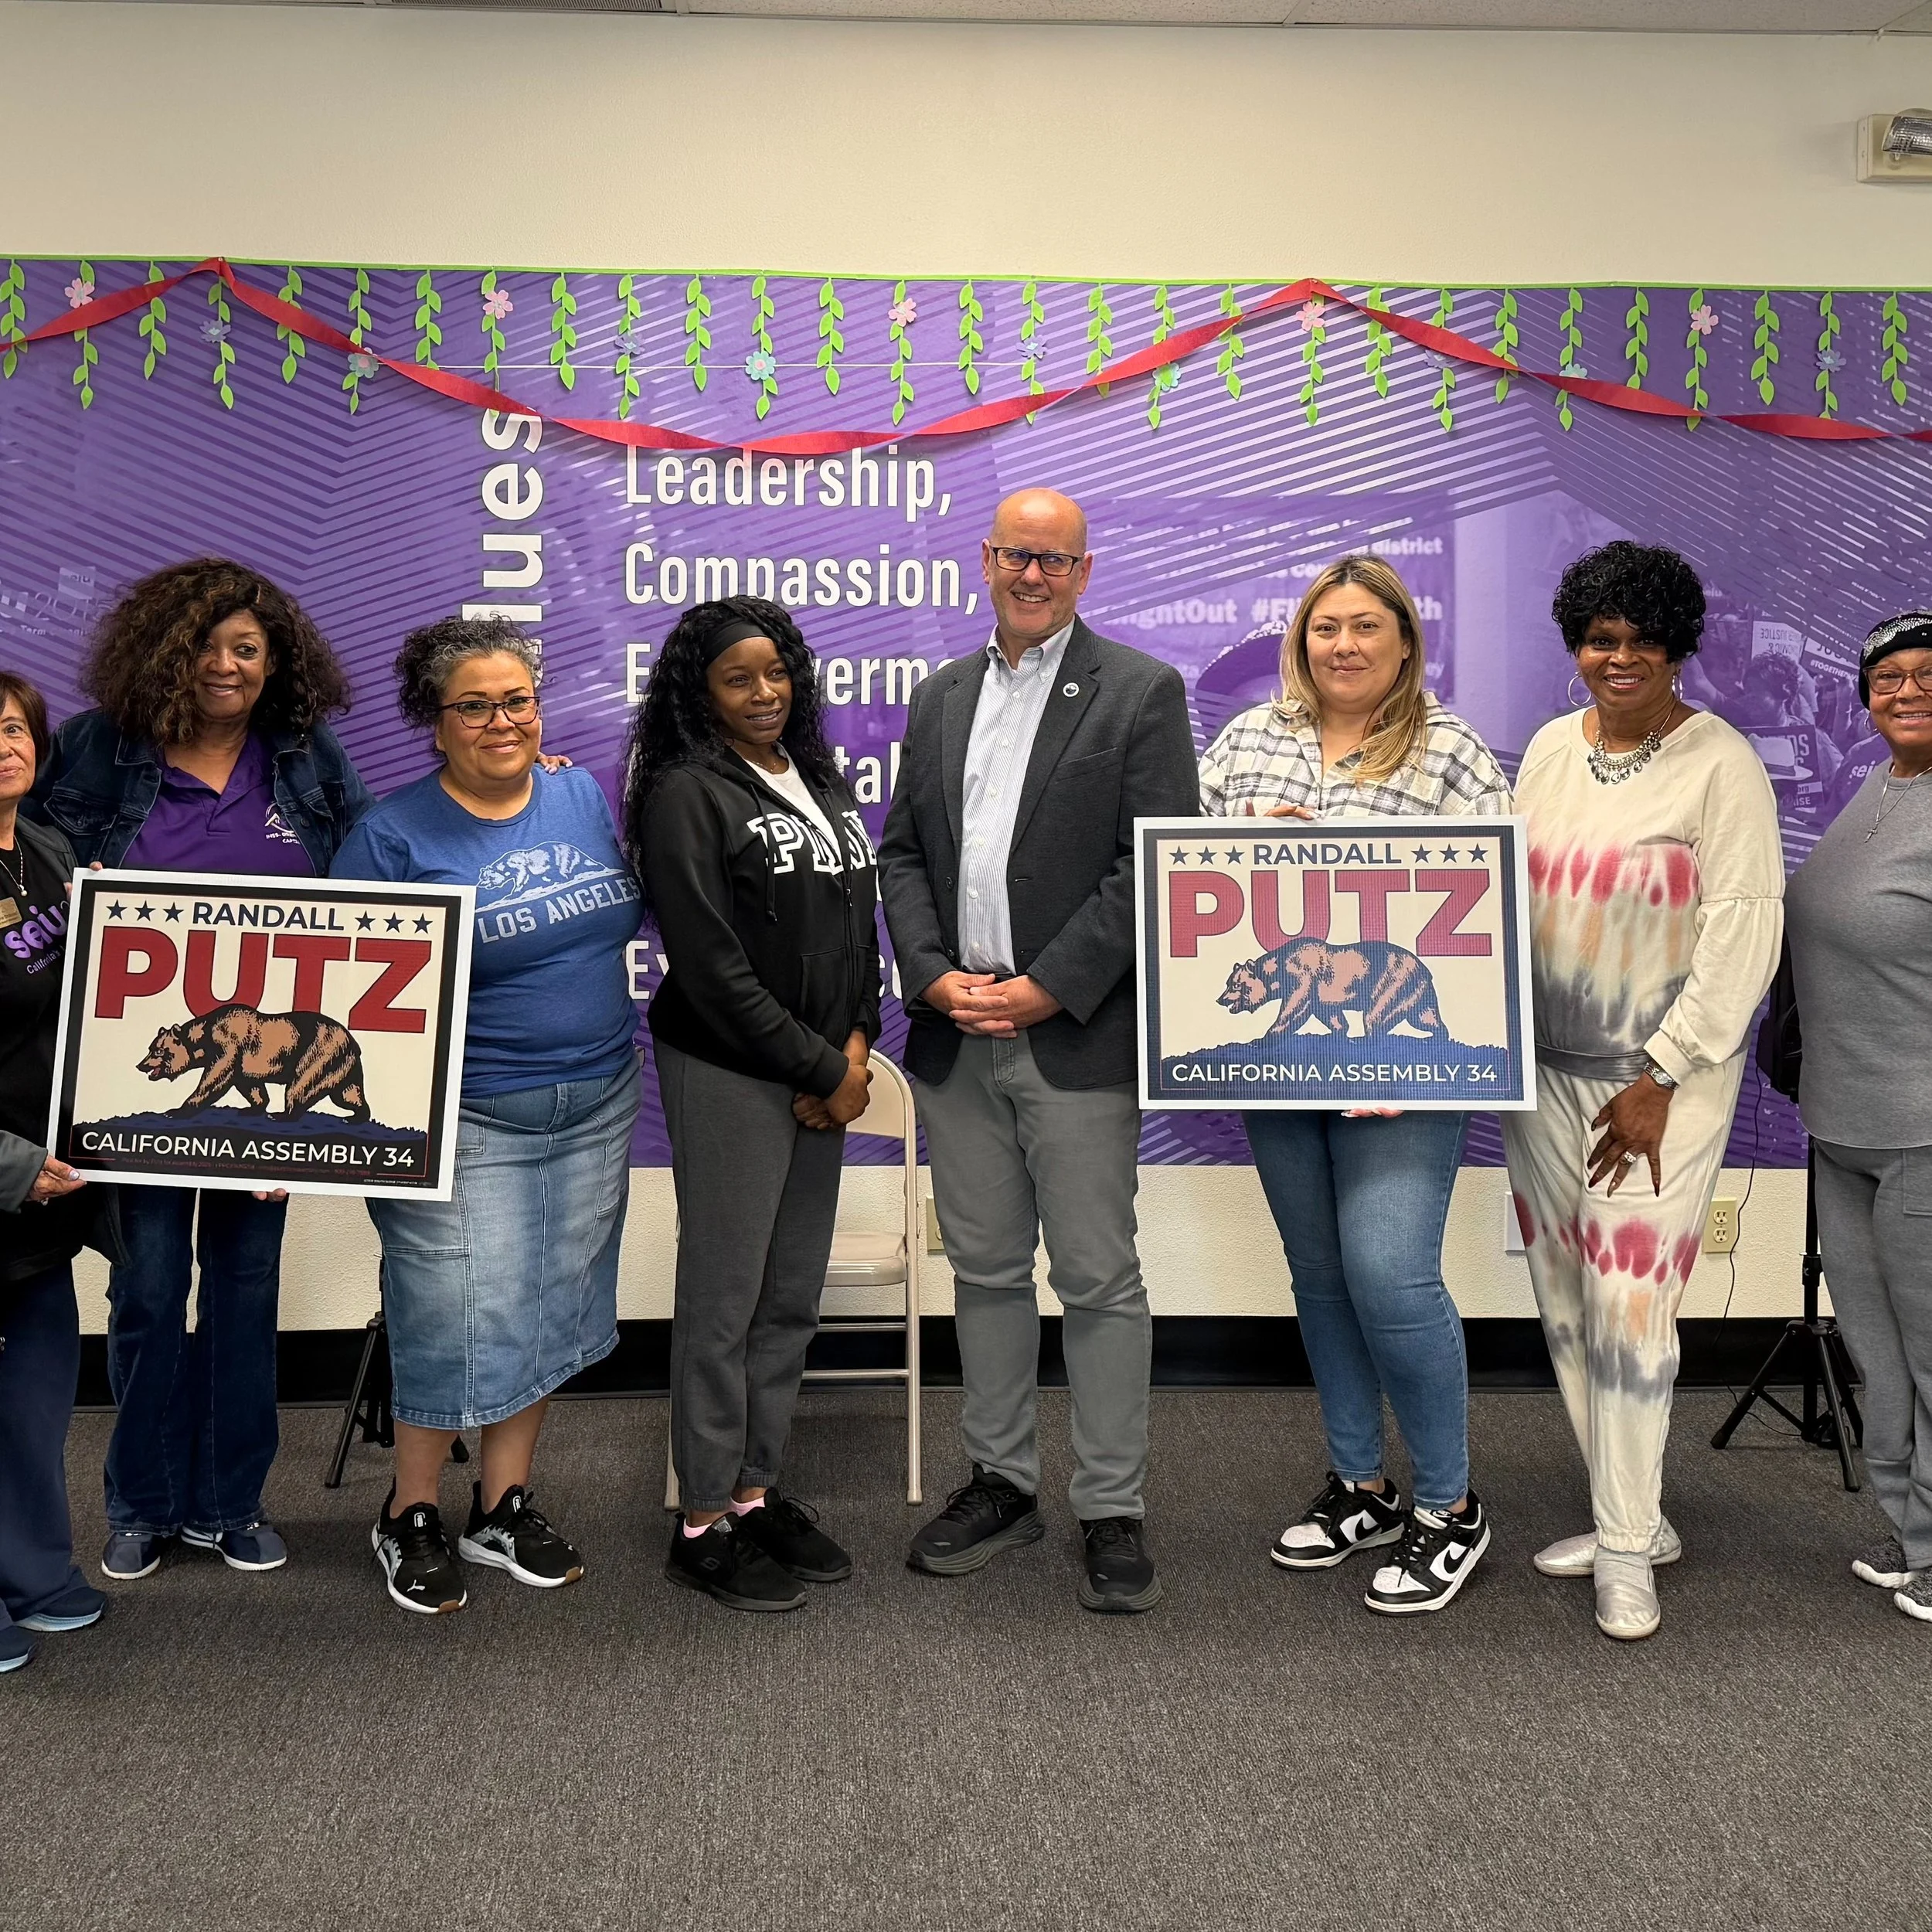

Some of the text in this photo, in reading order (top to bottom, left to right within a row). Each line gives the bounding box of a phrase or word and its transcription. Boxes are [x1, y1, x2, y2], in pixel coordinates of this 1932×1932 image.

[626, 444, 952, 523] Leadership,
[624, 542, 979, 615] Compassion,
[1849, 760, 1876, 779] sei
[1253, 843, 1402, 865] RANDALL
[192, 902, 345, 931] RANDALL
[478, 876, 641, 944] LOS ANGELES
[1168, 869, 1492, 957] PUTZ
[94, 926, 433, 1034] PUTZ
[1172, 1064, 1497, 1083] CALIFORNIA ASSEMBLY 34
[82, 1131, 236, 1159] CALIFORNIA
[241, 1141, 378, 1165] ASSEMBLY
[383, 1147, 415, 1168] 34
